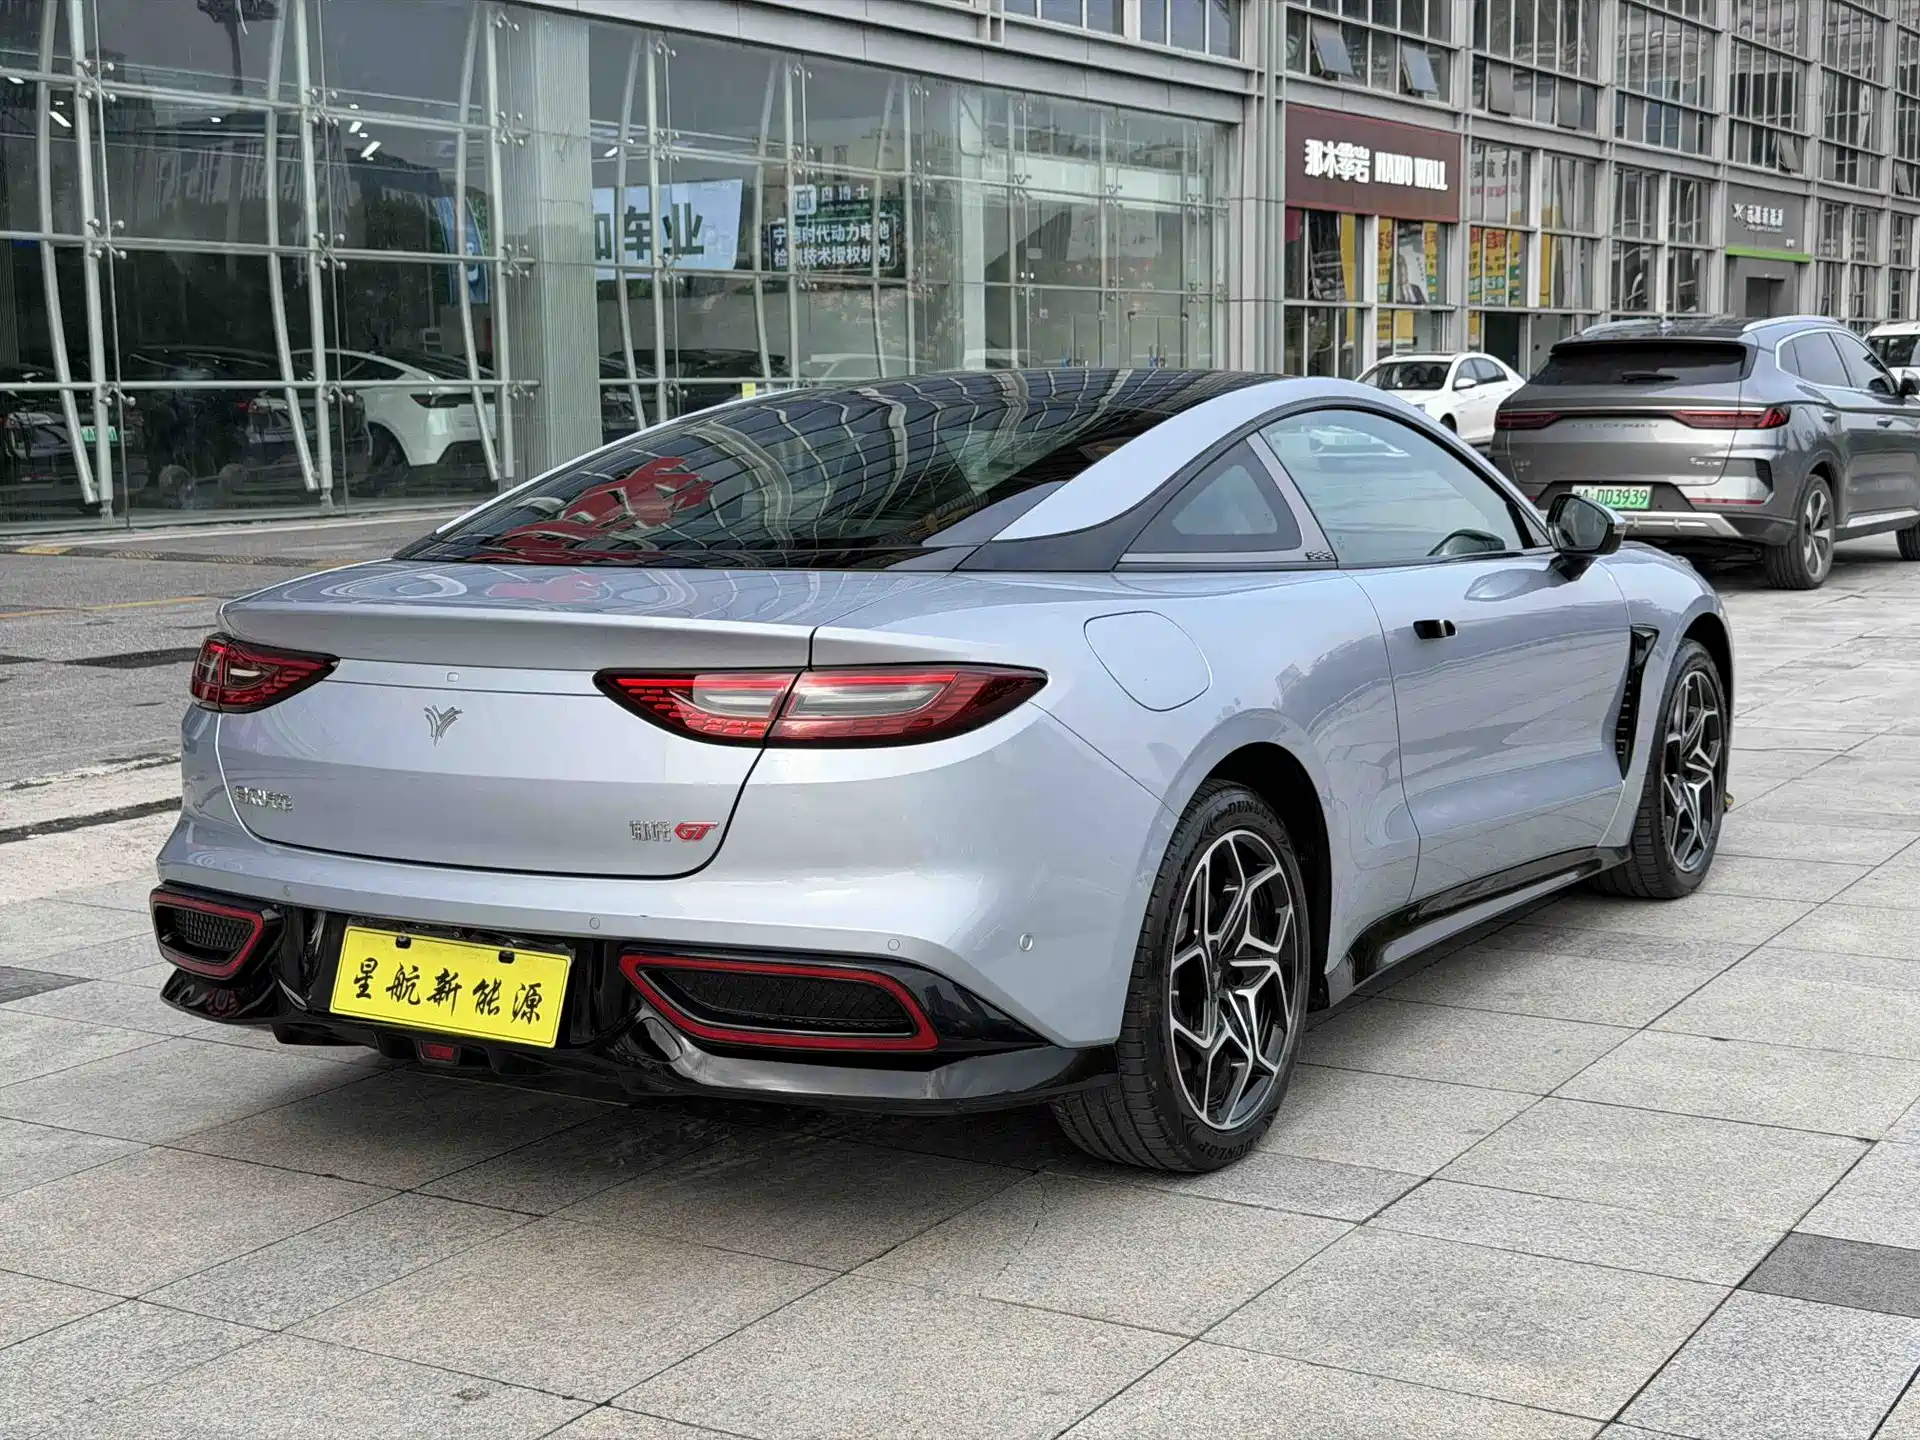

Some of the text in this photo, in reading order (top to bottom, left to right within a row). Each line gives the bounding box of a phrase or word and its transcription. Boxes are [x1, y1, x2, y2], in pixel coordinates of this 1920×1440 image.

[1414, 157, 1448, 191] WALL
[674, 820, 719, 841] GT
[353, 957, 543, 1025] 星航新能源
